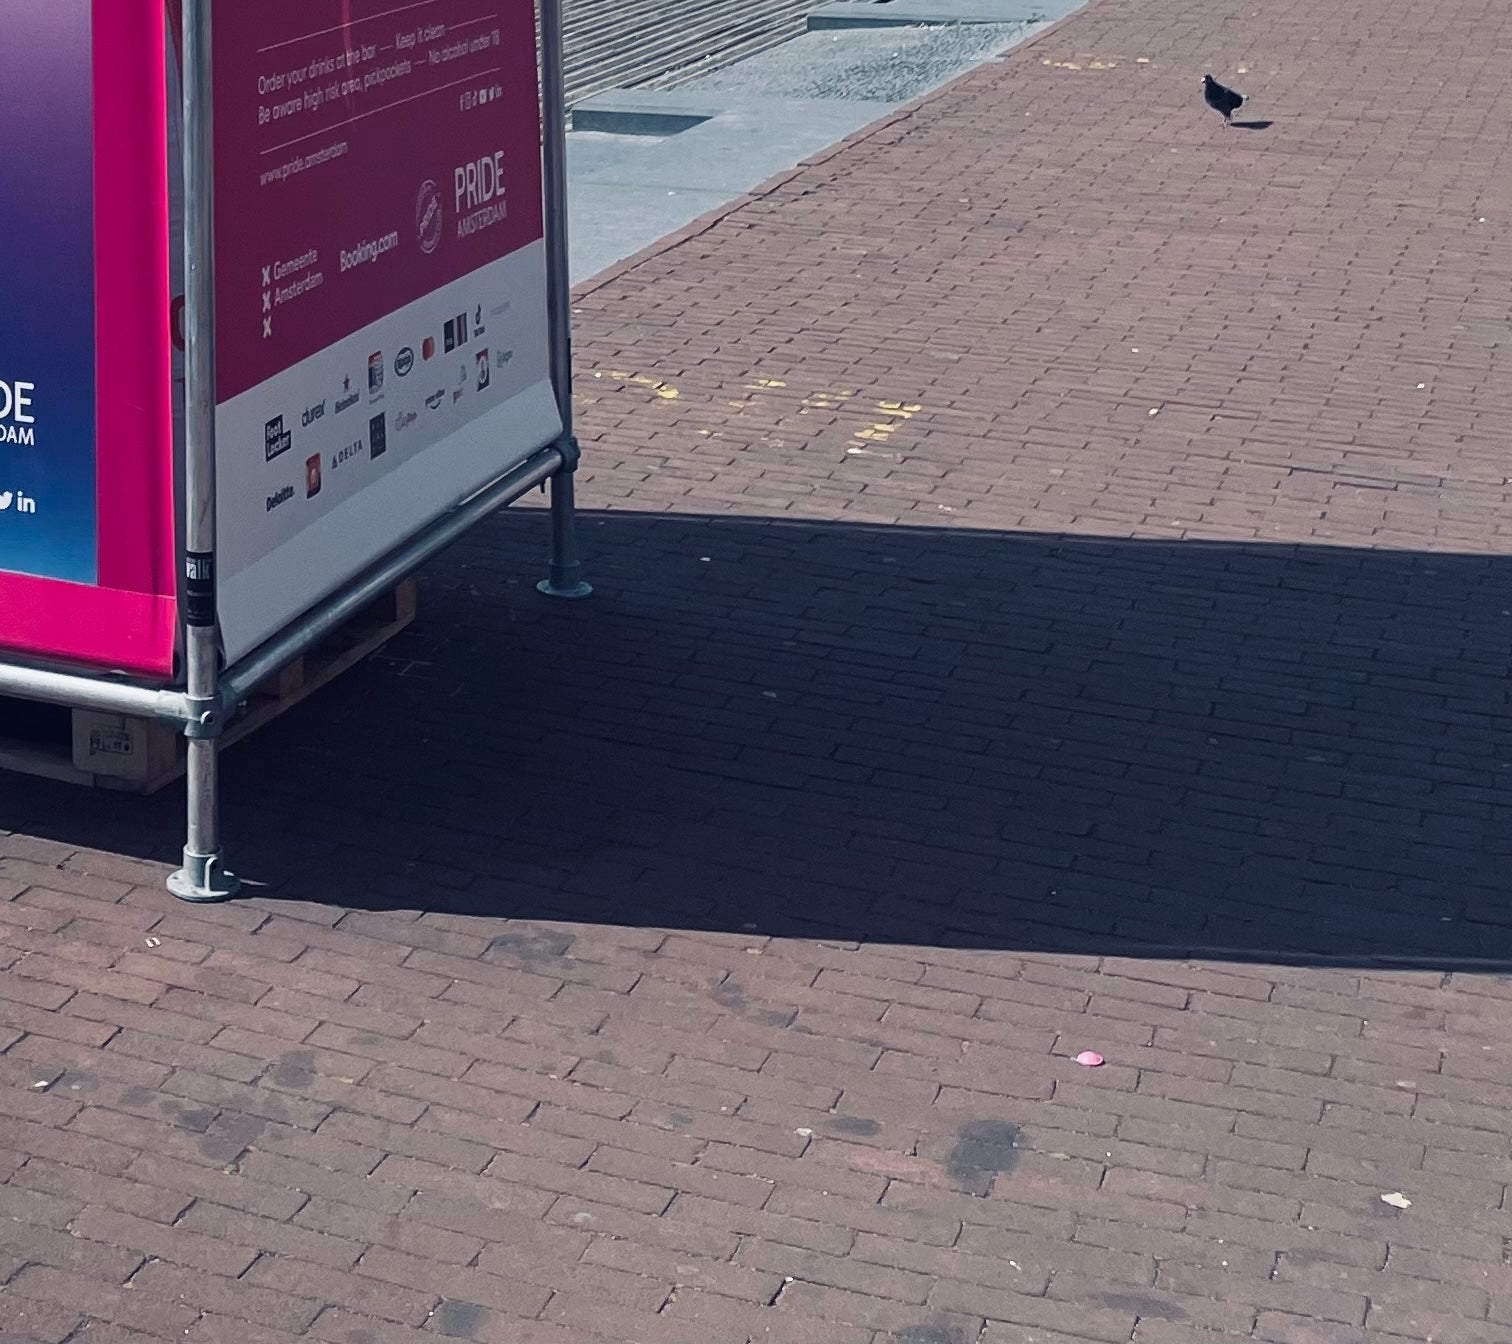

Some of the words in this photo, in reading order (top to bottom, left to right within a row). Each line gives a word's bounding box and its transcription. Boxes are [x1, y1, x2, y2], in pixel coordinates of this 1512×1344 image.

[395, 32, 415, 48] Keep
[258, 74, 285, 94] Order
[286, 67, 307, 88] your
[308, 58, 334, 78] drinks
[346, 50, 359, 66] the
[361, 45, 375, 60] bar
[258, 106, 270, 124] Be
[303, 88, 323, 110] high
[325, 82, 339, 100] risk
[454, 151, 505, 212] PRIDE
[273, 249, 317, 279] Gemeente
[340, 231, 398, 271] Booking.com
[274, 272, 323, 304] Amsterdam
